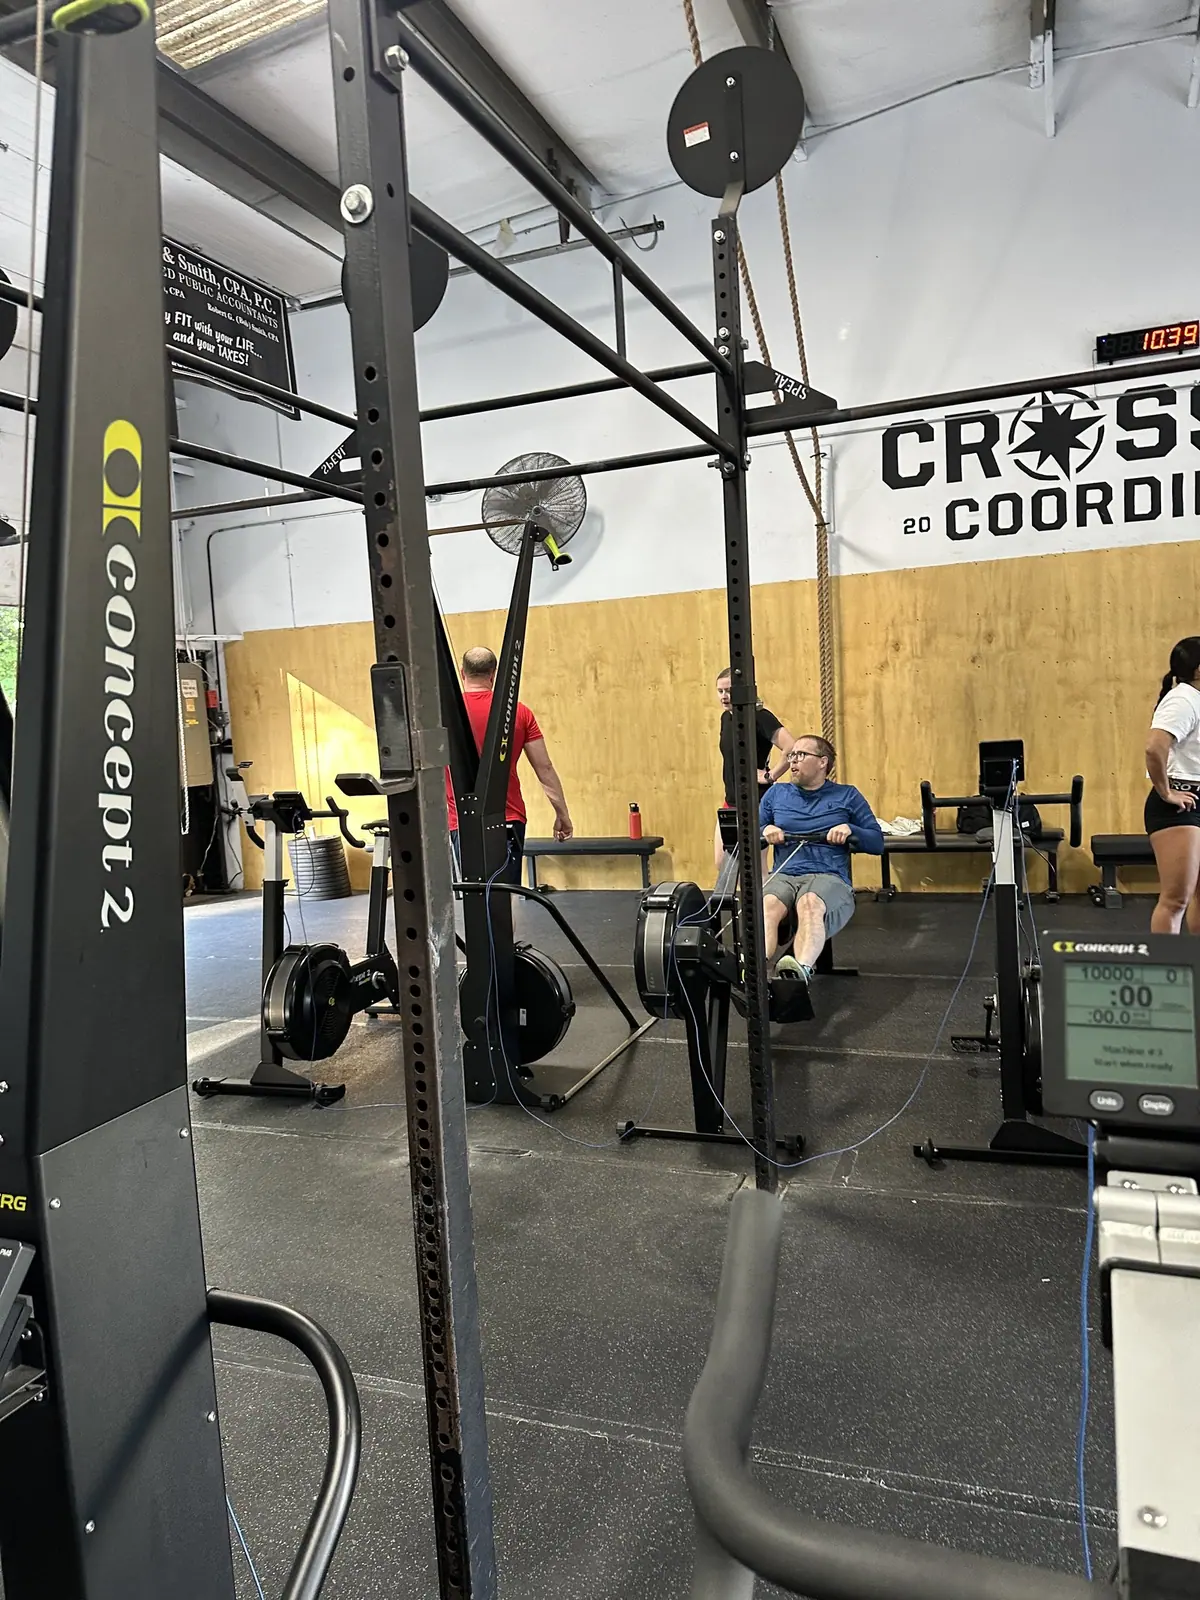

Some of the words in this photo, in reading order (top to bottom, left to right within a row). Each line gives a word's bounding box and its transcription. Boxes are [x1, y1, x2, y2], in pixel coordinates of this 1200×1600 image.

[163, 246, 175, 264] &
[178, 253, 220, 290] Smith,
[223, 276, 252, 306] CPA,
[253, 291, 276, 315] P.C.
[169, 286, 186, 299] CPA
[178, 272, 214, 298] PUBLIC
[216, 291, 278, 329] ACCOUNTANTS
[174, 310, 192, 328] FIT
[194, 321, 213, 337] with
[215, 330, 234, 346] your
[172, 331, 194, 345] and
[196, 338, 215, 354] your
[217, 343, 249, 366] TAXES!
[903, 516, 931, 535] 20
[945, 470, 1200, 541] COORDI
[98, 543, 137, 873] concept
[101, 886, 135, 929] 2
[1074, 943, 1135, 955] concept
[1082, 966, 1134, 981] 10000
[1142, 1099, 1171, 1112] Display
[0, 1193, 27, 1211] RG
